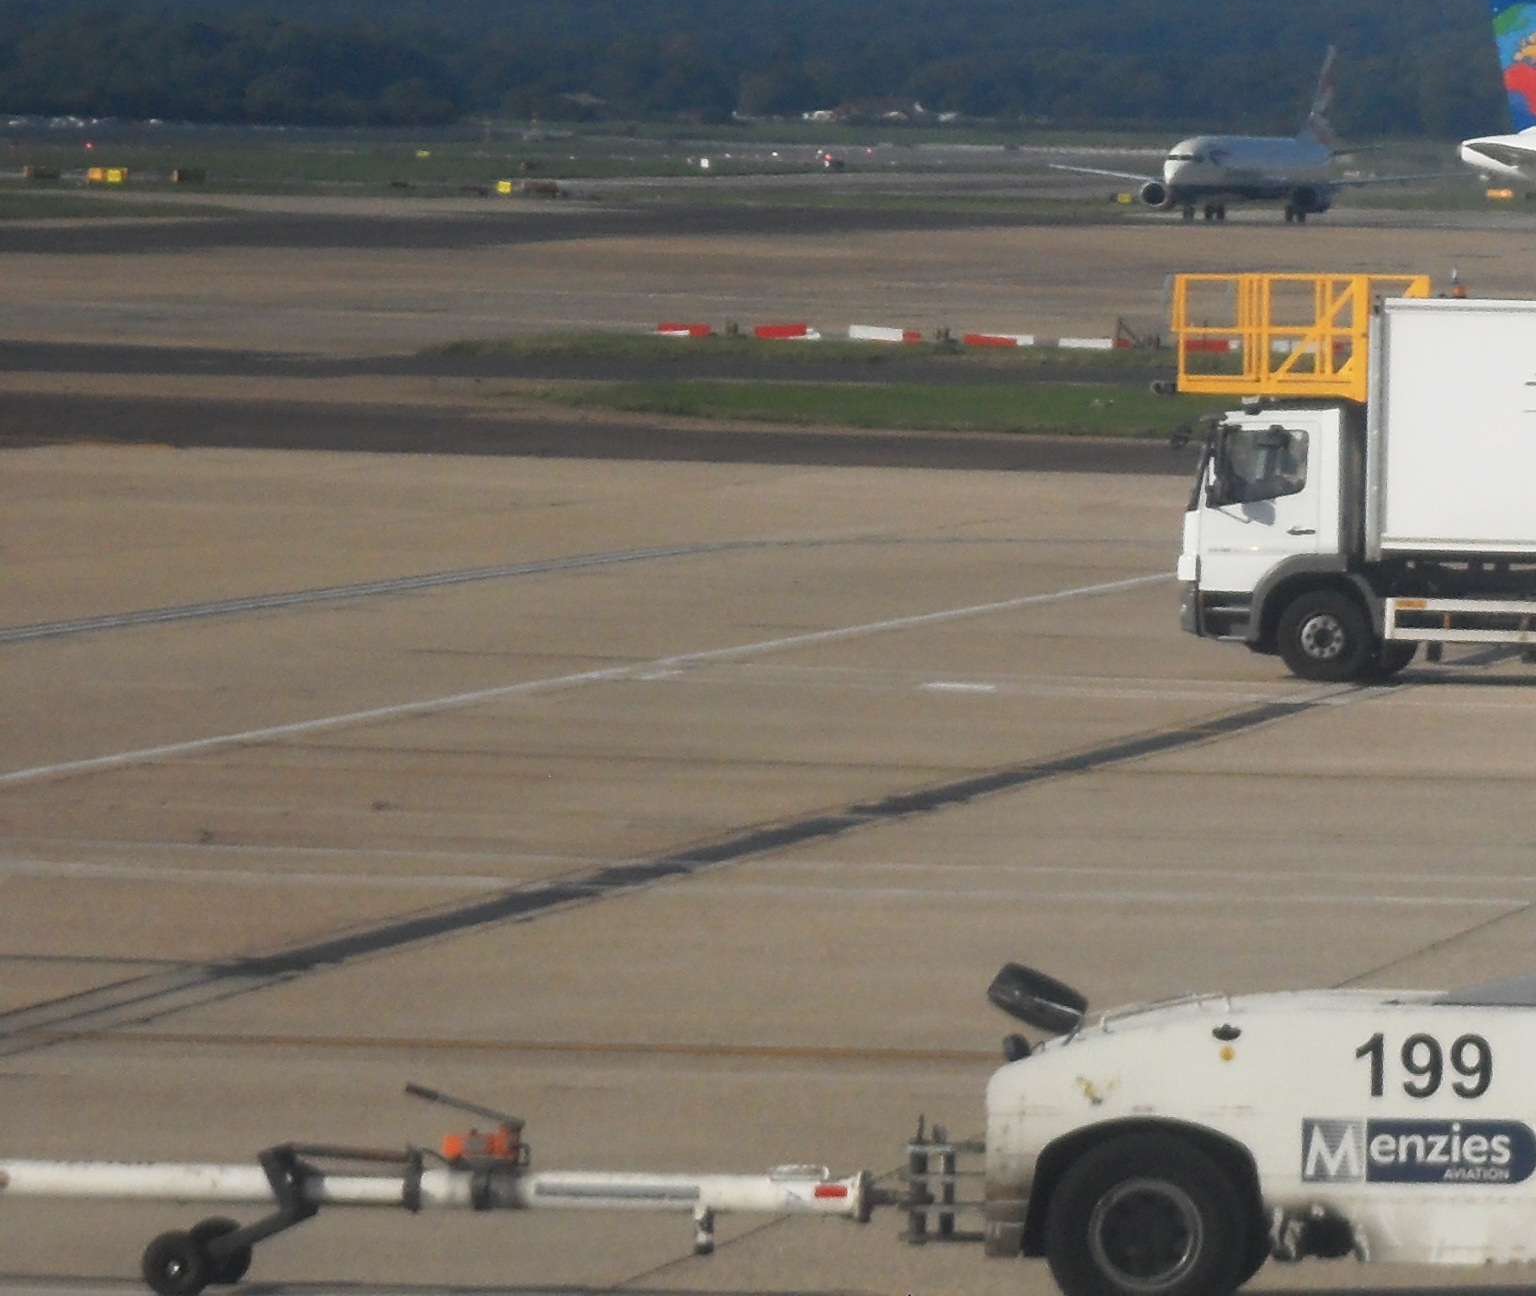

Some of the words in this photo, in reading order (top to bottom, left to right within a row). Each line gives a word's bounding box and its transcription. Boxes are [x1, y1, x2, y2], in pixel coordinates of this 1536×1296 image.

[1356, 1032, 1492, 1098] 199
[1306, 1122, 1511, 1177] Menzies
[1443, 1167, 1510, 1180] AVIATION
